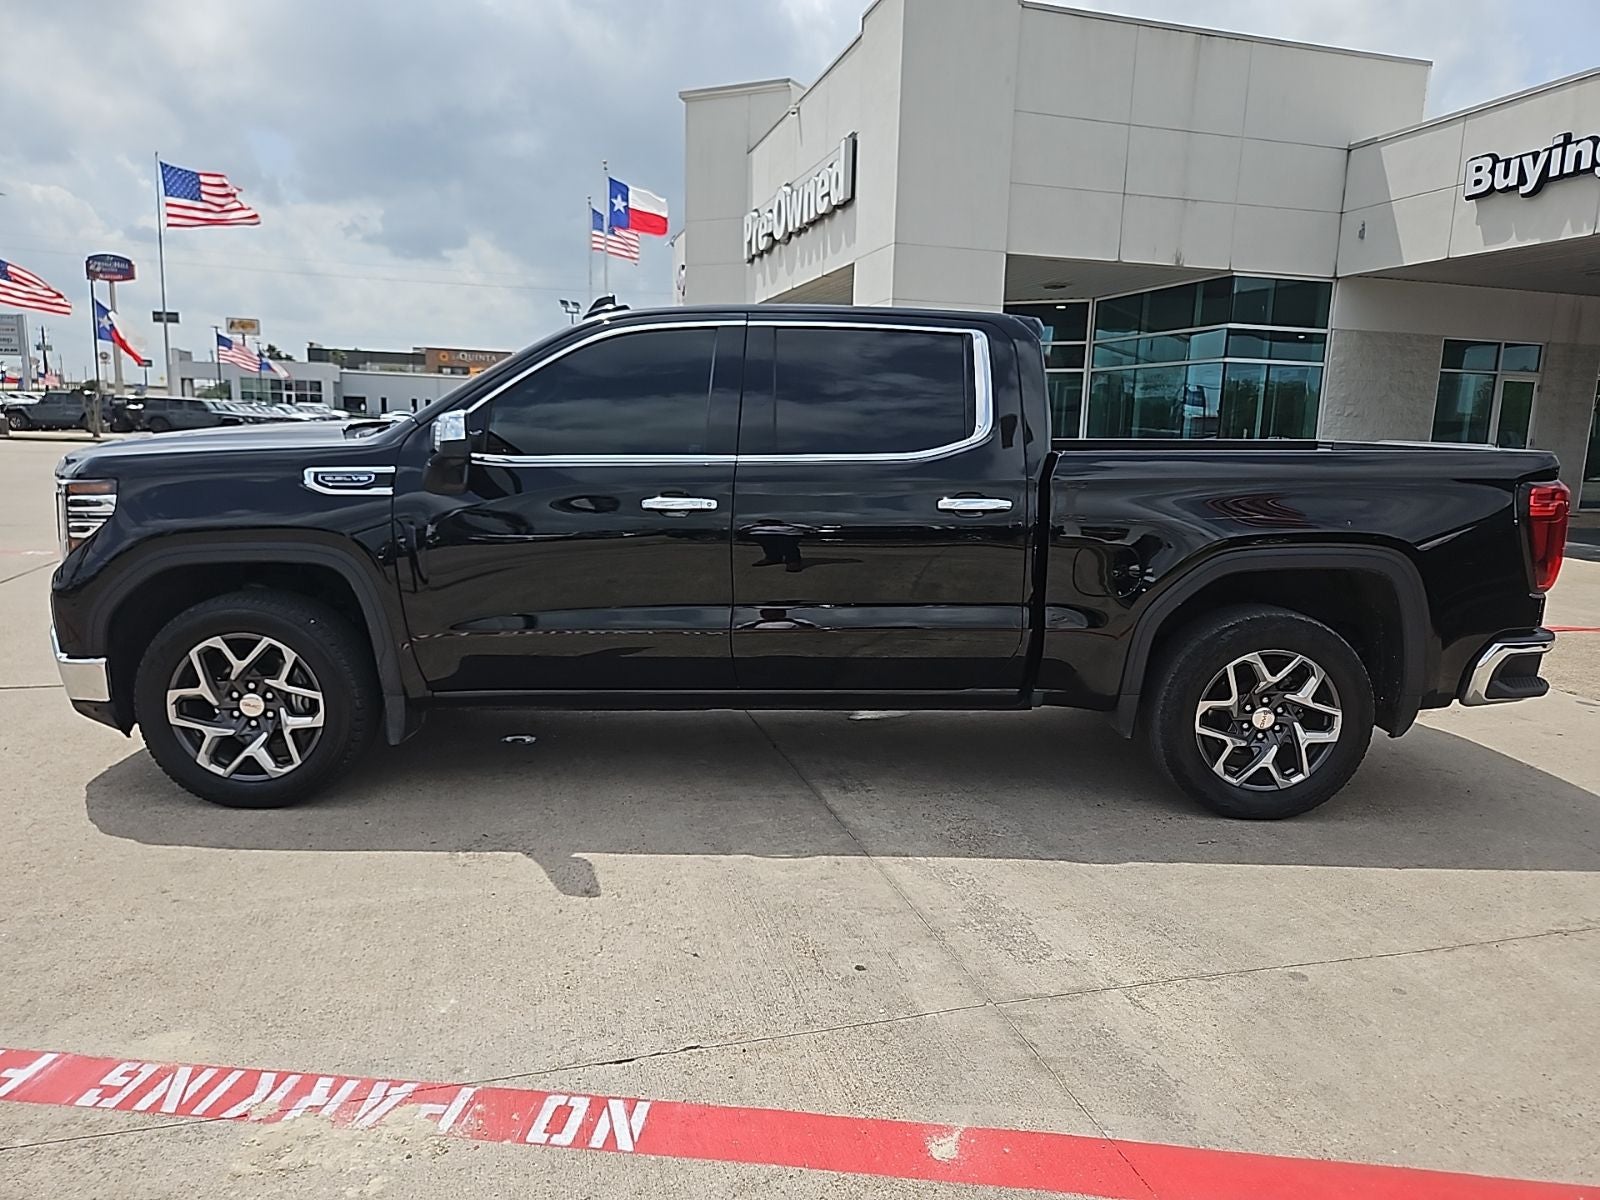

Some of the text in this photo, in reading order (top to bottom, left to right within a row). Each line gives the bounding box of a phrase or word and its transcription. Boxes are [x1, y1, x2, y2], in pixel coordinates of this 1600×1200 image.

[1464, 133, 1600, 198] Buyin
[744, 137, 857, 262] Pre-Owned
[460, 352, 497, 362] QUINTA
[525, 1094, 652, 1152] NO
